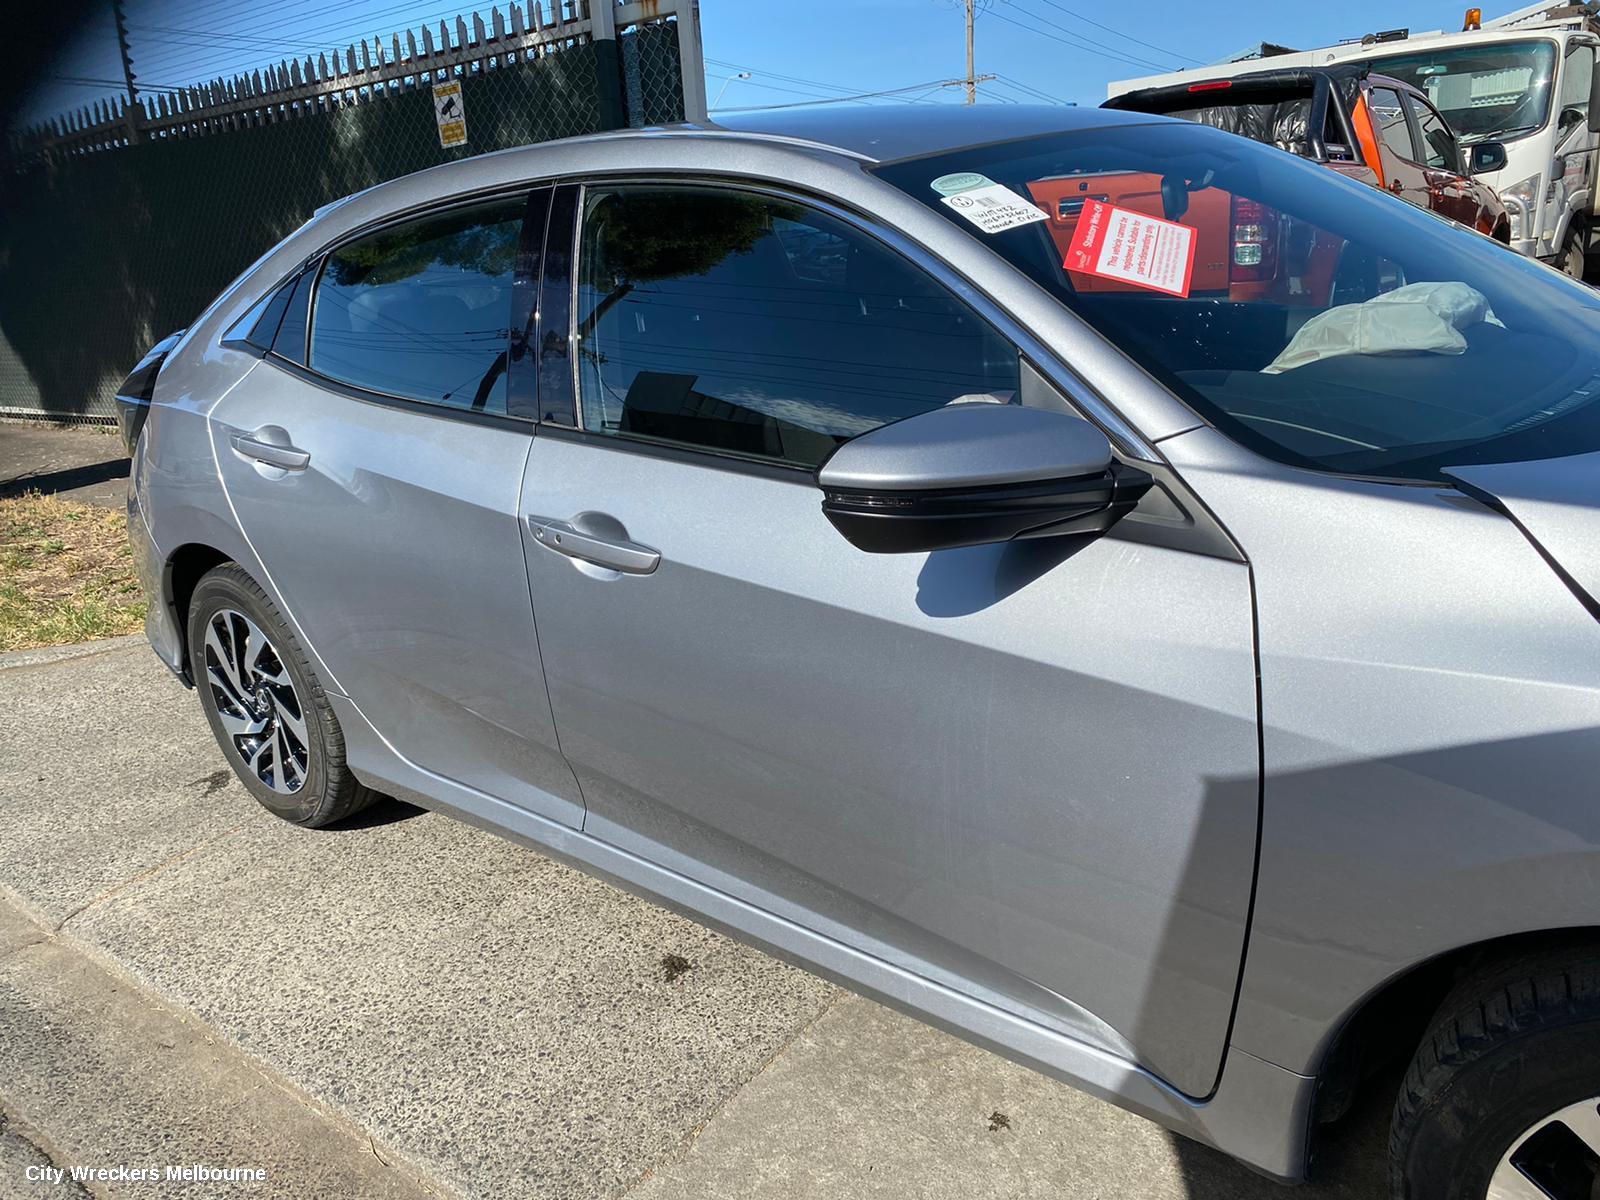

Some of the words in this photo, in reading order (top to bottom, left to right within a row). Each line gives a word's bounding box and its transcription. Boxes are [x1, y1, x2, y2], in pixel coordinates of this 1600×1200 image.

[1082, 223, 1100, 248] Statutory
[1115, 222, 1126, 238] cannot
[1128, 226, 1140, 244] Suitable
[1110, 238, 1122, 255] vehicle
[1107, 255, 1118, 267] This
